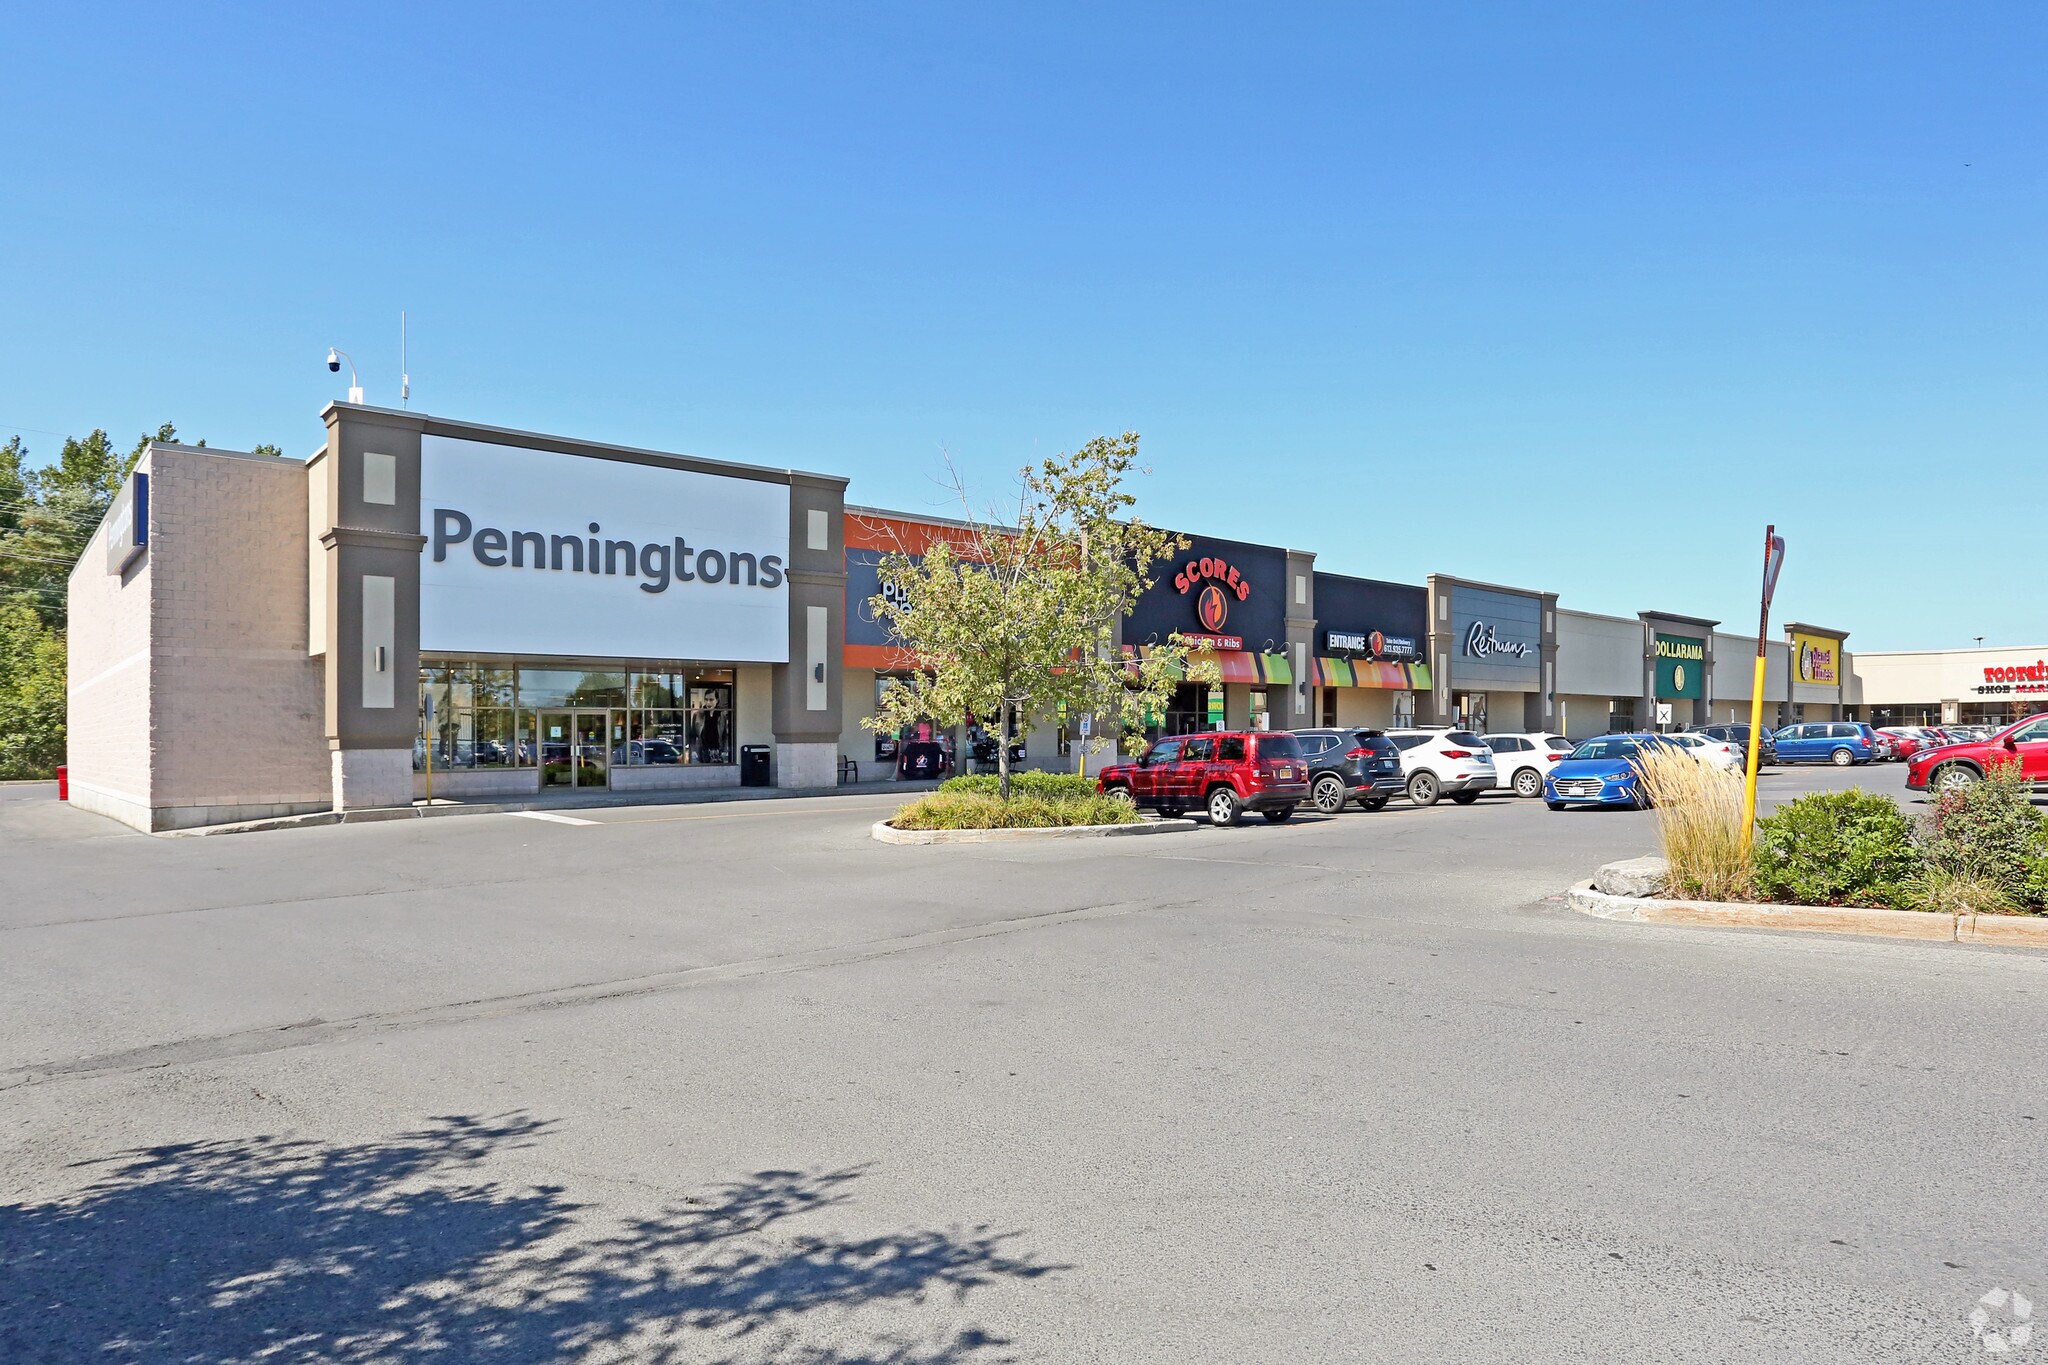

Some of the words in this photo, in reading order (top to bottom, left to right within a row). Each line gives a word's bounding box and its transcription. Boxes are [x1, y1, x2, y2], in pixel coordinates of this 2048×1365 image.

[433, 508, 783, 593] Penningtons
[1175, 557, 1250, 601] SCORES
[1217, 638, 1223, 647] &
[1224, 638, 1240, 648] Ribs
[1330, 634, 1366, 650] ENTRANCE
[1467, 621, 1533, 658] Reitmans
[1655, 641, 1704, 660] DOLLARAMA
[1978, 685, 2010, 694] SHOE
